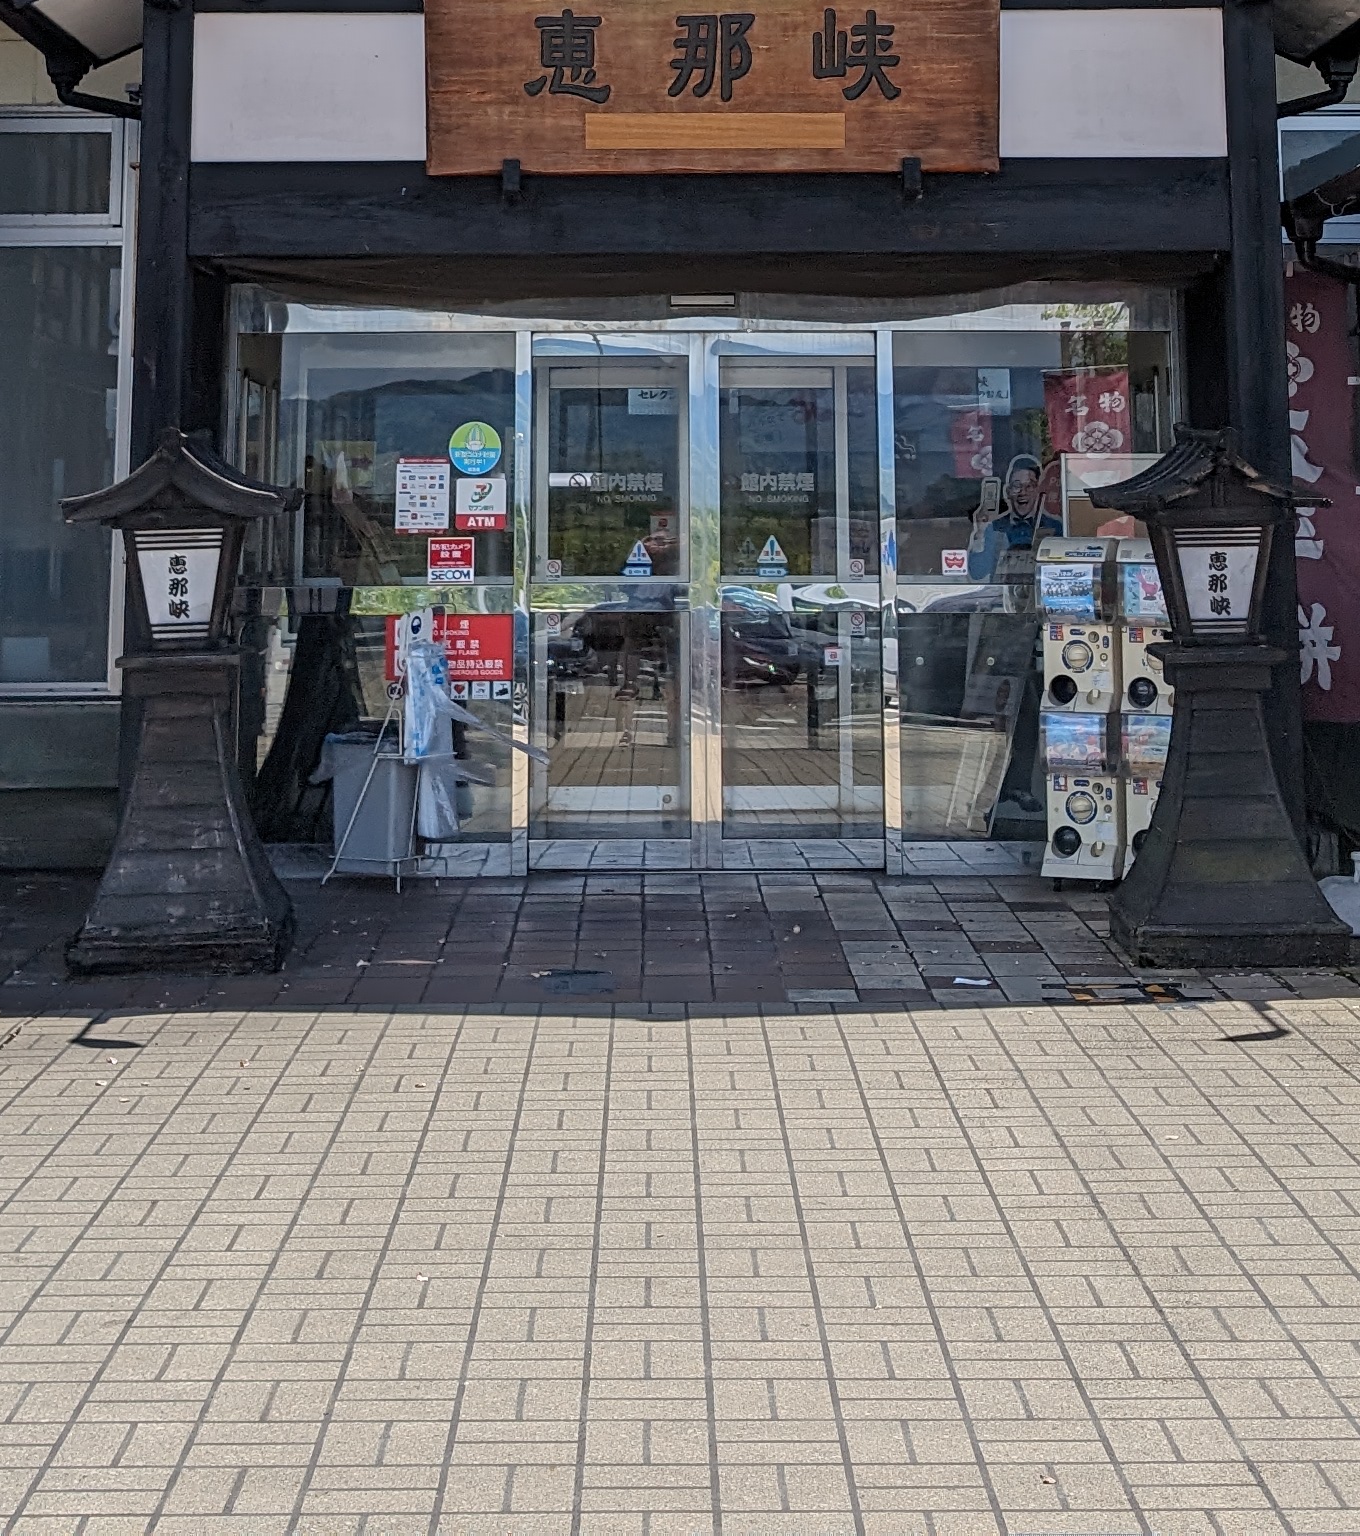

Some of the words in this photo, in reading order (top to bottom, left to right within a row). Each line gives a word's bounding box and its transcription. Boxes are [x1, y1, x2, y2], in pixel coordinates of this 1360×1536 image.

[524, 7, 901, 104] 恵那峡
[638, 389, 674, 400] セレク
[590, 472, 663, 492] 館内禁煙
[741, 472, 815, 492] 館内禁煙
[597, 495, 610, 503] NO
[749, 495, 762, 503] NO
[767, 495, 810, 503] SMOKING
[467, 517, 496, 527] ATM
[431, 570, 471, 581] SECOM
[168, 552, 191, 619] 恵那峡
[1207, 551, 1232, 616] 恵那峡
